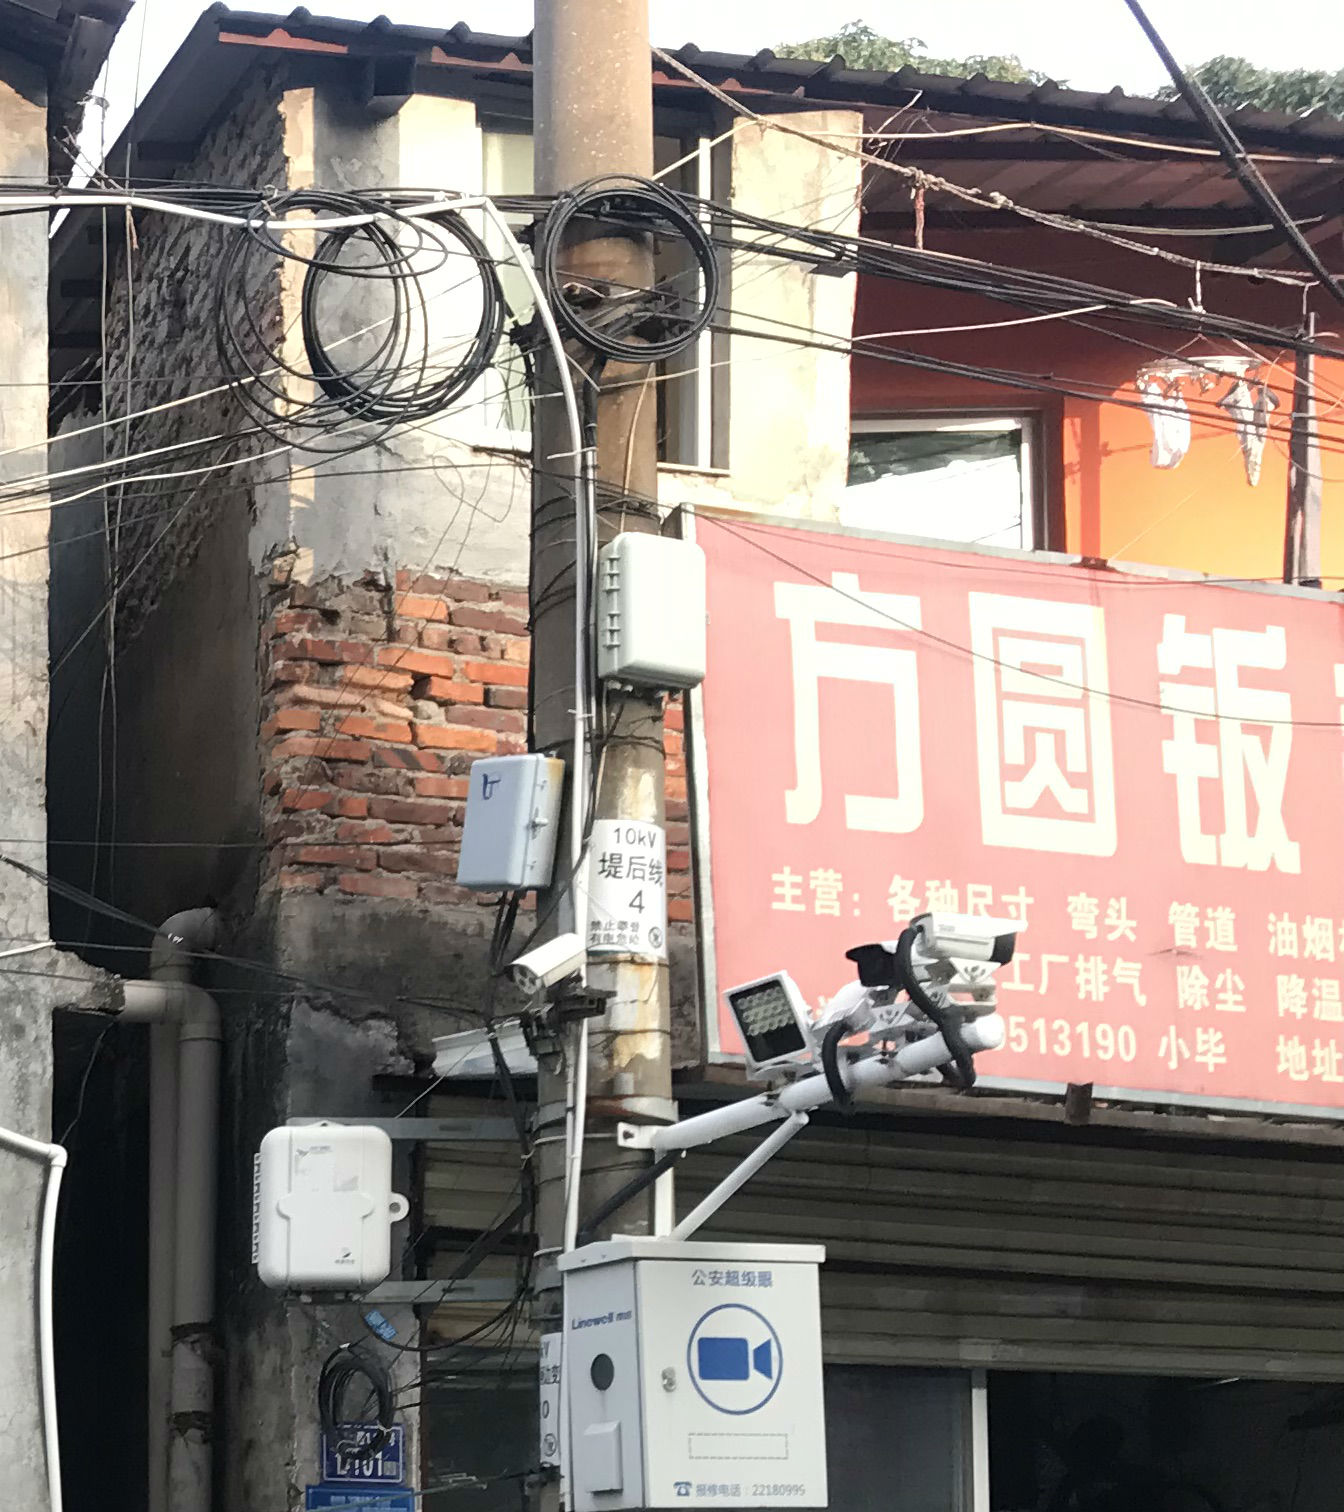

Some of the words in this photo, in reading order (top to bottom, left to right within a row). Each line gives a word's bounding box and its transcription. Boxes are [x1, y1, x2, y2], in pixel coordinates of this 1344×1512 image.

[773, 571, 1344, 875] 方圆钣
[614, 827, 657, 849] 10kV
[628, 889, 646, 914] 4
[1067, 892, 1138, 943] 弯头
[1168, 900, 1239, 953] 管道
[1268, 911, 1344, 963] 油烟
[1176, 964, 1248, 1013] 除尘
[1276, 973, 1344, 1023] 降温
[1158, 1024, 1228, 1074] 小毕
[1276, 1034, 1344, 1084] 地址
